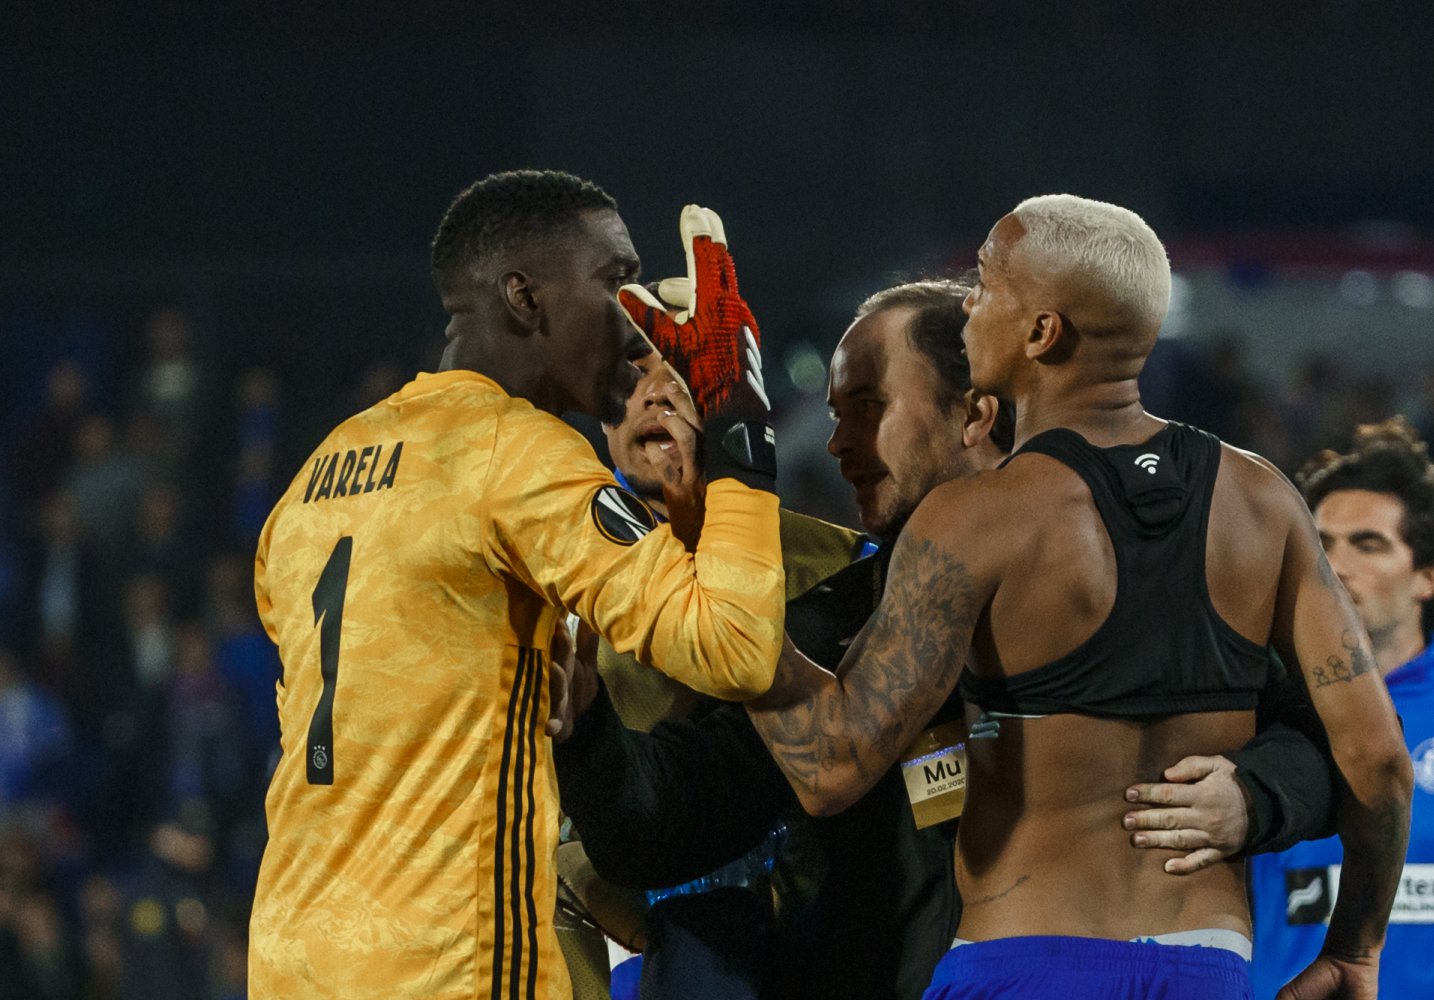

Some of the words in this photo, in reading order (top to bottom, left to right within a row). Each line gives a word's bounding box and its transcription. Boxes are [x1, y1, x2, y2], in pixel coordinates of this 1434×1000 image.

[302, 441, 404, 504] VARELA
[306, 535, 353, 785] 1
[923, 760, 962, 784] Mu
